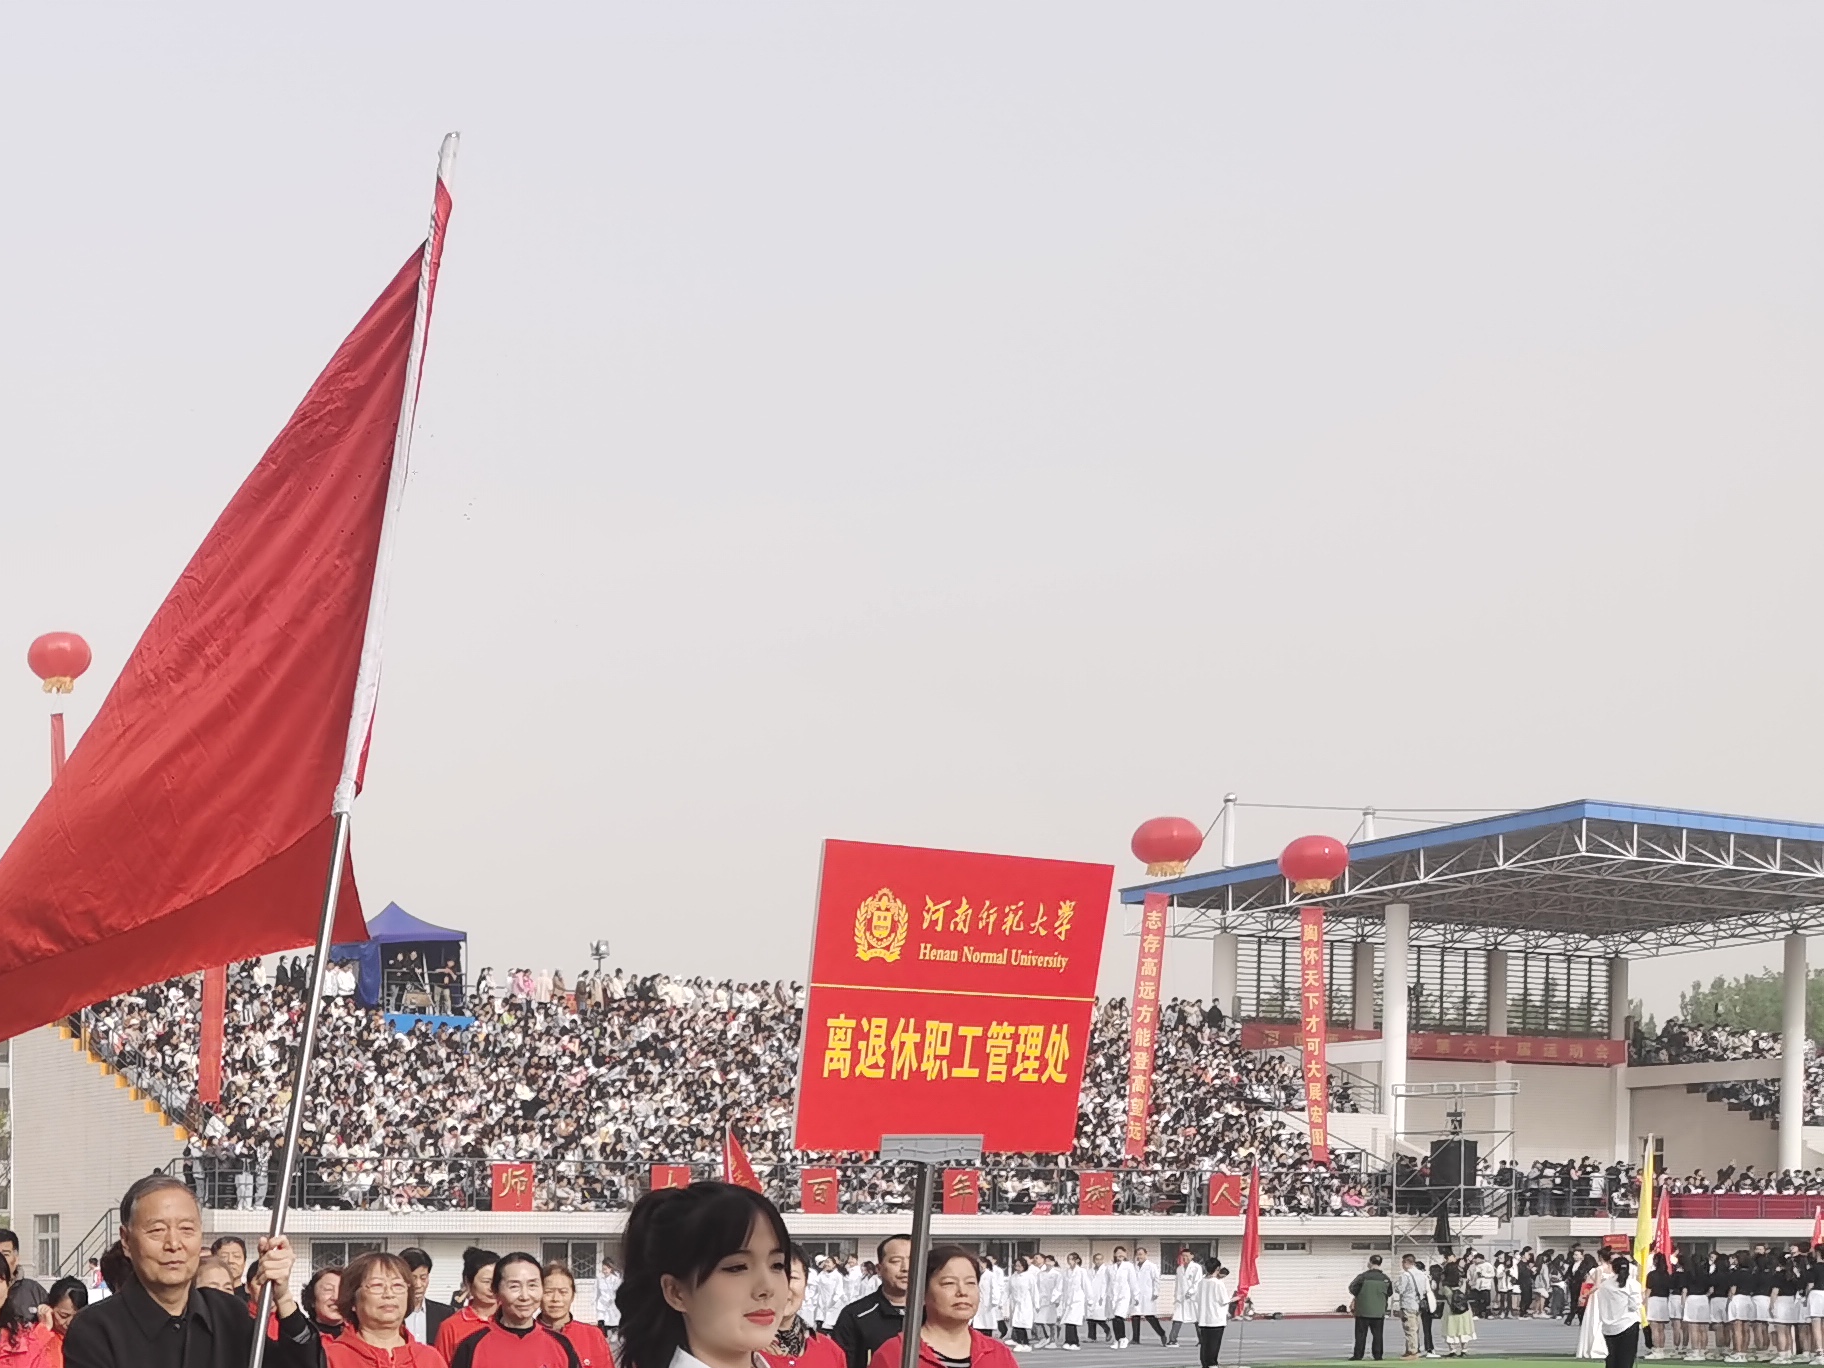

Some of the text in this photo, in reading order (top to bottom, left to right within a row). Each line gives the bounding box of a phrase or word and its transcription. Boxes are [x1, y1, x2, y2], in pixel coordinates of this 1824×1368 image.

[918, 942, 1069, 973] Henan Normal University
[822, 1012, 1070, 1084] 离退休职工管理处
[1128, 909, 1163, 1142] 志存高远方能登高望远
[1302, 923, 1325, 1147] 胸怀天下才可大展宏图
[499, 1167, 529, 1208] 师
[807, 1176, 834, 1205] 百
[949, 1173, 974, 1212] 年
[1212, 1182, 1240, 1208] 人
